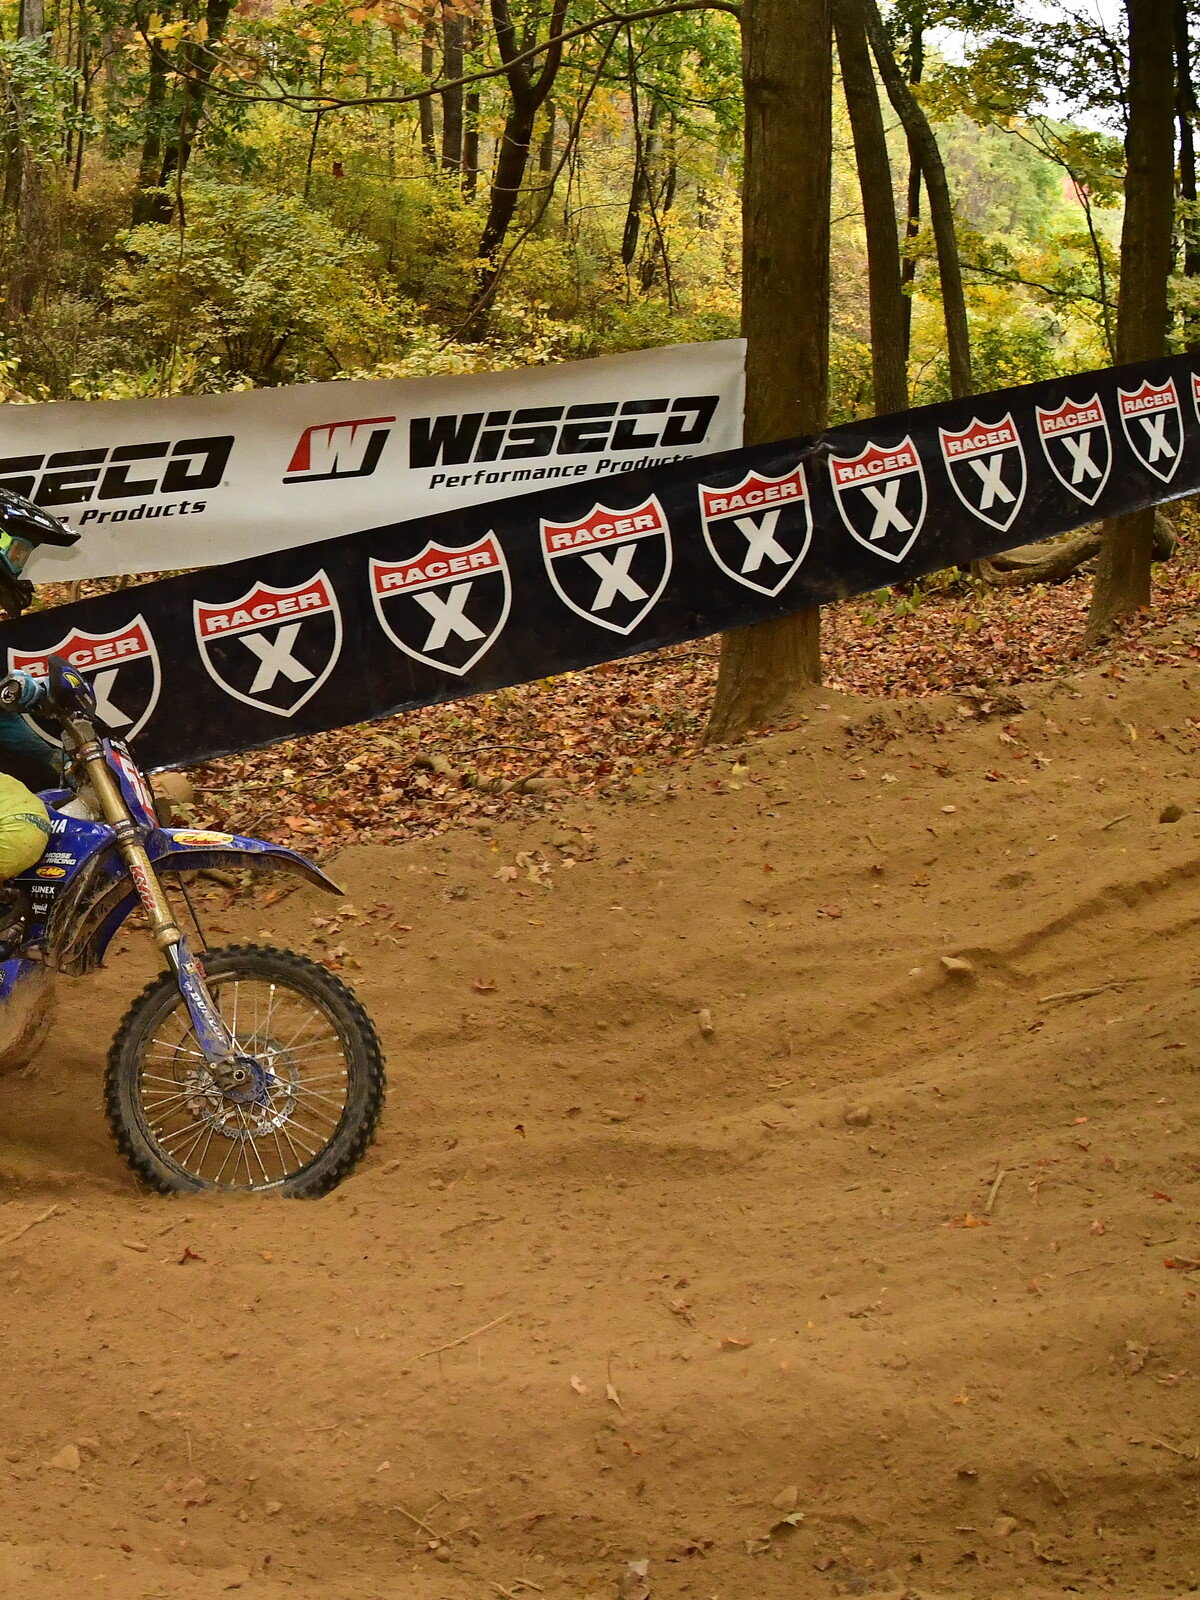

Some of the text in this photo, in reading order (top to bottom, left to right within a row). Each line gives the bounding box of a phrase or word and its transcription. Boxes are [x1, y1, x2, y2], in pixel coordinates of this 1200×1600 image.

[1042, 409, 1100, 432] RACER
[1123, 392, 1174, 413] RACER
[947, 429, 1013, 454] RACER
[1138, 413, 1177, 463] X
[429, 460, 588, 490] Performance
[838, 452, 914, 482] RACER
[1060, 432, 1103, 485] X
[708, 482, 798, 514] RACER
[968, 453, 1017, 510] X
[78, 498, 208, 526] Products
[860, 479, 914, 541] X
[551, 515, 656, 549] RACER
[733, 509, 793, 574] X
[380, 551, 493, 589] RACER
[580, 543, 650, 612] X
[205, 592, 324, 632] RACER
[411, 581, 488, 652] X
[21, 637, 141, 676] RCER
[237, 622, 317, 694] X
[30, 885, 56, 895] SUNEX
